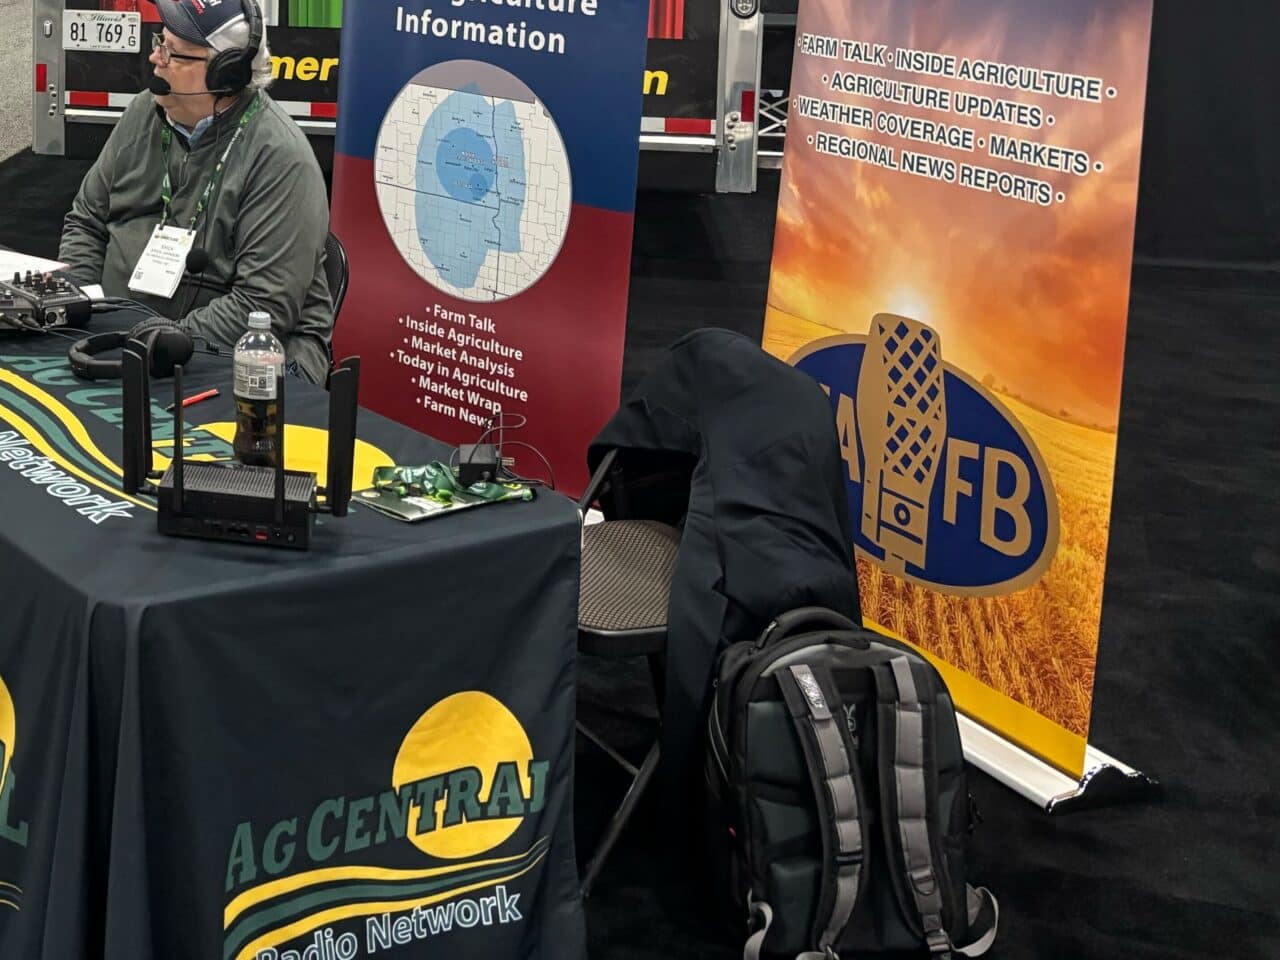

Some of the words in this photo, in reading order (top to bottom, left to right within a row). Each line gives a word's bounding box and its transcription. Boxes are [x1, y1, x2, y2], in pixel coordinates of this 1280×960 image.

[70, 22, 87, 42] 81
[97, 23, 123, 44] 769
[396, 6, 566, 55] Information
[801, 34, 837, 58] FARM
[841, 40, 886, 66] TALK
[894, 48, 955, 76] INSIDE
[958, 58, 1102, 101] AGRICULTURE
[831, 72, 951, 110] AGRICULTURE
[953, 94, 1043, 128] UPDATES
[798, 95, 874, 129] WEATHER
[876, 112, 975, 150] COVERAGE
[989, 134, 1089, 175] MARKETS
[816, 133, 897, 168] REGIONAL
[901, 151, 956, 182] NEWS
[959, 165, 1052, 205] REPORTS
[406, 315, 445, 338] Inside
[448, 328, 523, 361] Agriculture
[433, 304, 465, 325] Farm
[468, 314, 497, 333] Talk
[397, 349, 435, 375] Today
[437, 361, 449, 377] in
[452, 368, 528, 402] Agriculture
[411, 336, 457, 361] Market
[459, 350, 515, 378] Analysis
[419, 375, 464, 401] Market
[467, 390, 502, 415] Wrap
[424, 396, 456, 418] Farm
[225, 816, 299, 892] AG
[366, 885, 524, 954] Network
